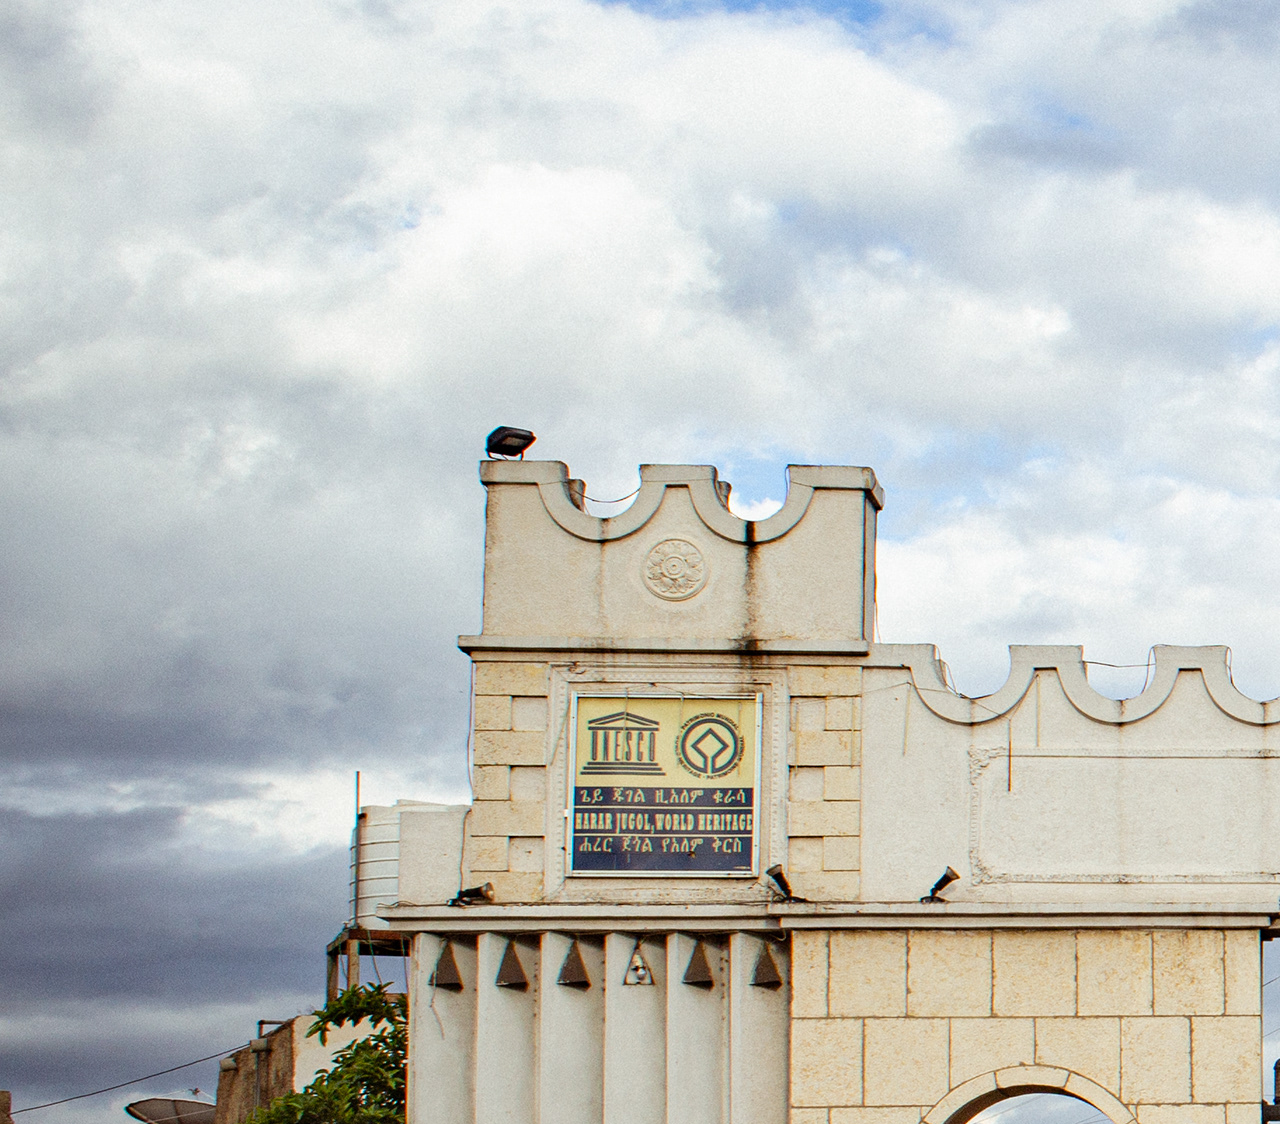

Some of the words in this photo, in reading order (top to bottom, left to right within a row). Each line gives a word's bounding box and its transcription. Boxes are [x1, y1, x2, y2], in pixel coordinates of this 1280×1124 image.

[591, 731, 656, 762] UNESCO
[575, 813, 613, 830] HARAR
[697, 814, 753, 831] HERITAGE
